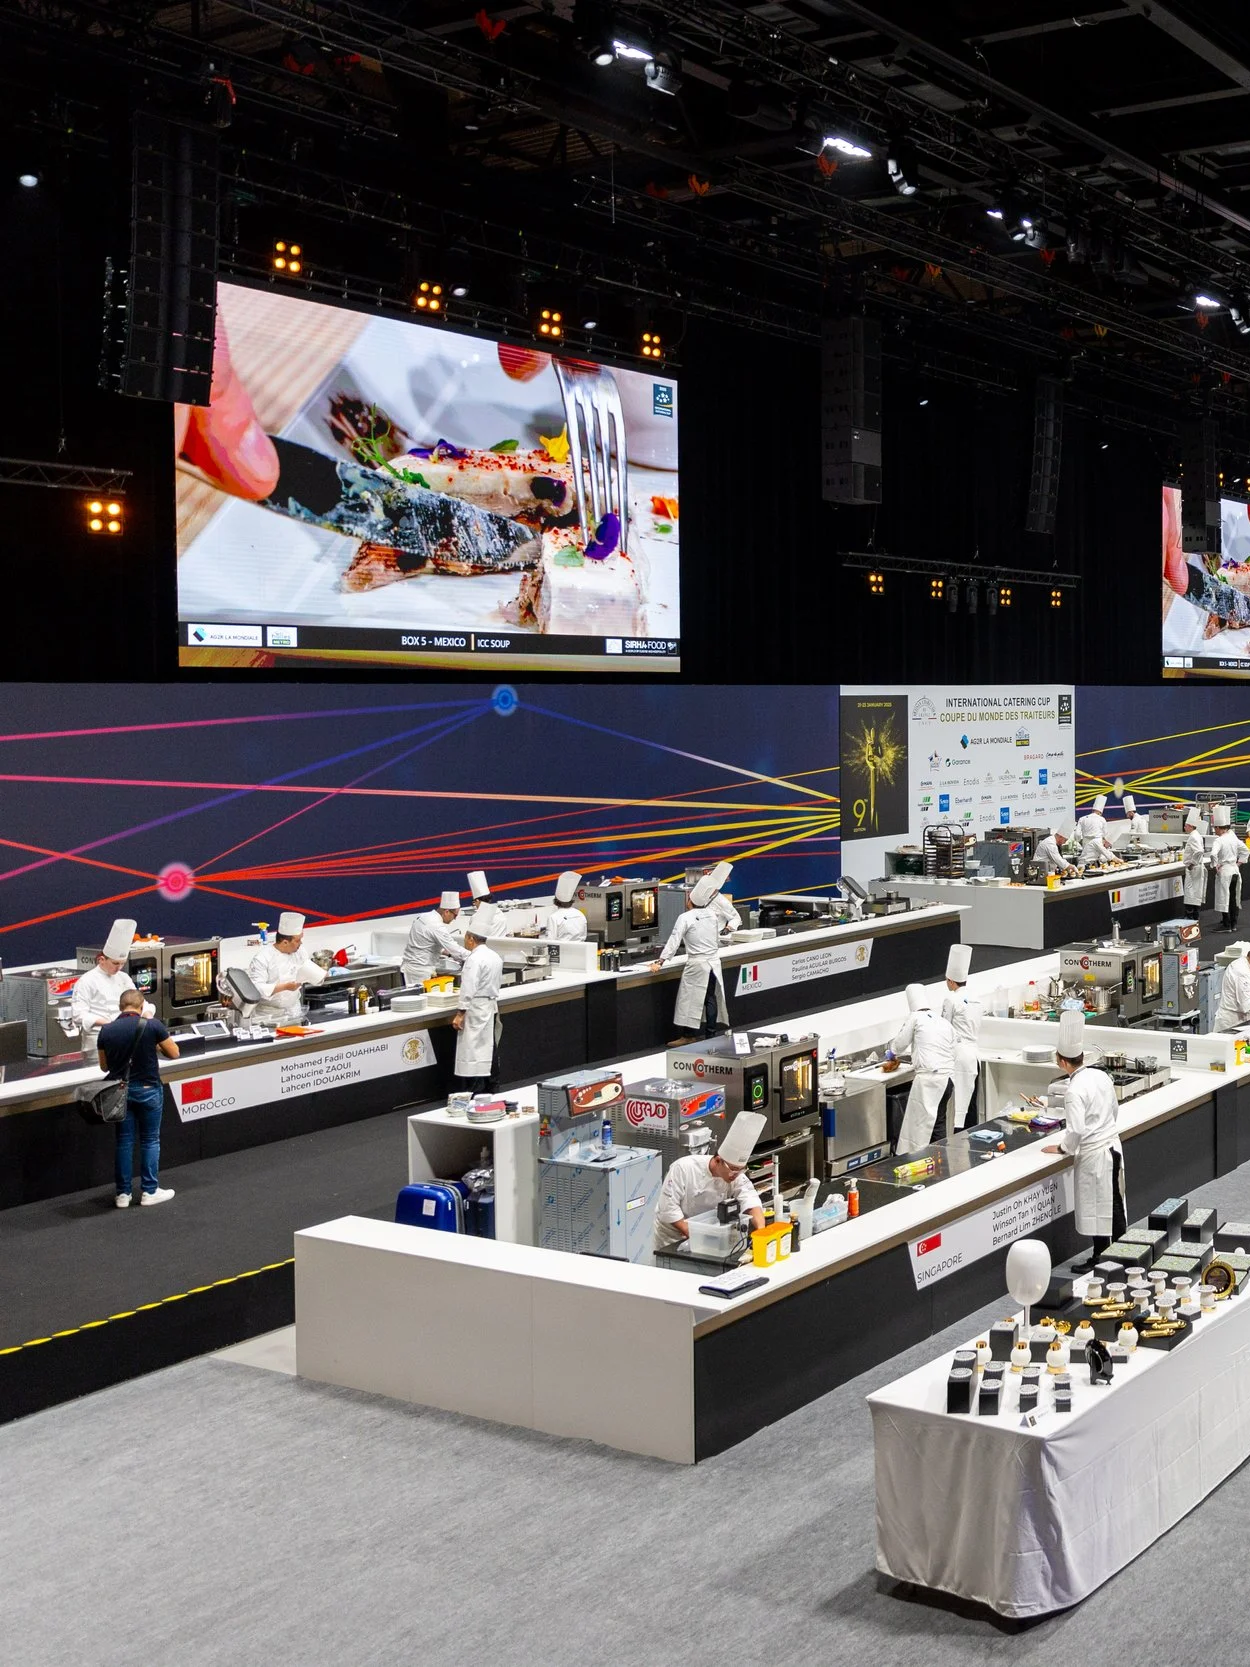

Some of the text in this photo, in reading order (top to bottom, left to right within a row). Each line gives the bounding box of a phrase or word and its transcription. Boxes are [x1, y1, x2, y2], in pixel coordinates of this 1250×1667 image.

[401, 636, 420, 646] BOX
[421, 637, 427, 646] 5
[434, 637, 466, 647] MEXICO
[477, 639, 511, 648] ICC SOUP
[648, 641, 667, 650] FOOD
[945, 696, 1051, 708] INTERNATIONAL CATERING CUP
[940, 710, 1056, 723] COUPE DU MONDE DES TRAITEURS
[990, 736, 1013, 744] MONDIALE
[1023, 753, 1045, 761] BRAGARD
[963, 777, 980, 786] Enodis
[806, 955, 820, 963] CANO
[1064, 957, 1112, 969] CONVOTHERM
[791, 965, 809, 973] Paulina
[791, 967, 830, 981] Sergio CAMACHO
[741, 981, 762, 991] MEXICO
[280, 1043, 389, 1073] Mohamed Fadil OUAHHABI
[280, 1061, 352, 1084] Lahoucine ZAOUI
[673, 1060, 733, 1076] CONVOTHERM
[280, 1069, 361, 1094] Lahcen IDOUAKRIM
[181, 1096, 236, 1116] MOROCCO
[631, 1101, 667, 1121] BRAVO
[992, 1182, 1058, 1221] Justin Oh KHAY YUEN
[992, 1194, 1056, 1233] Winson Tan YI QUAN
[992, 1204, 1062, 1246] Bernard Lim ZHENG LE
[917, 1252, 963, 1284] SINGAPORE
